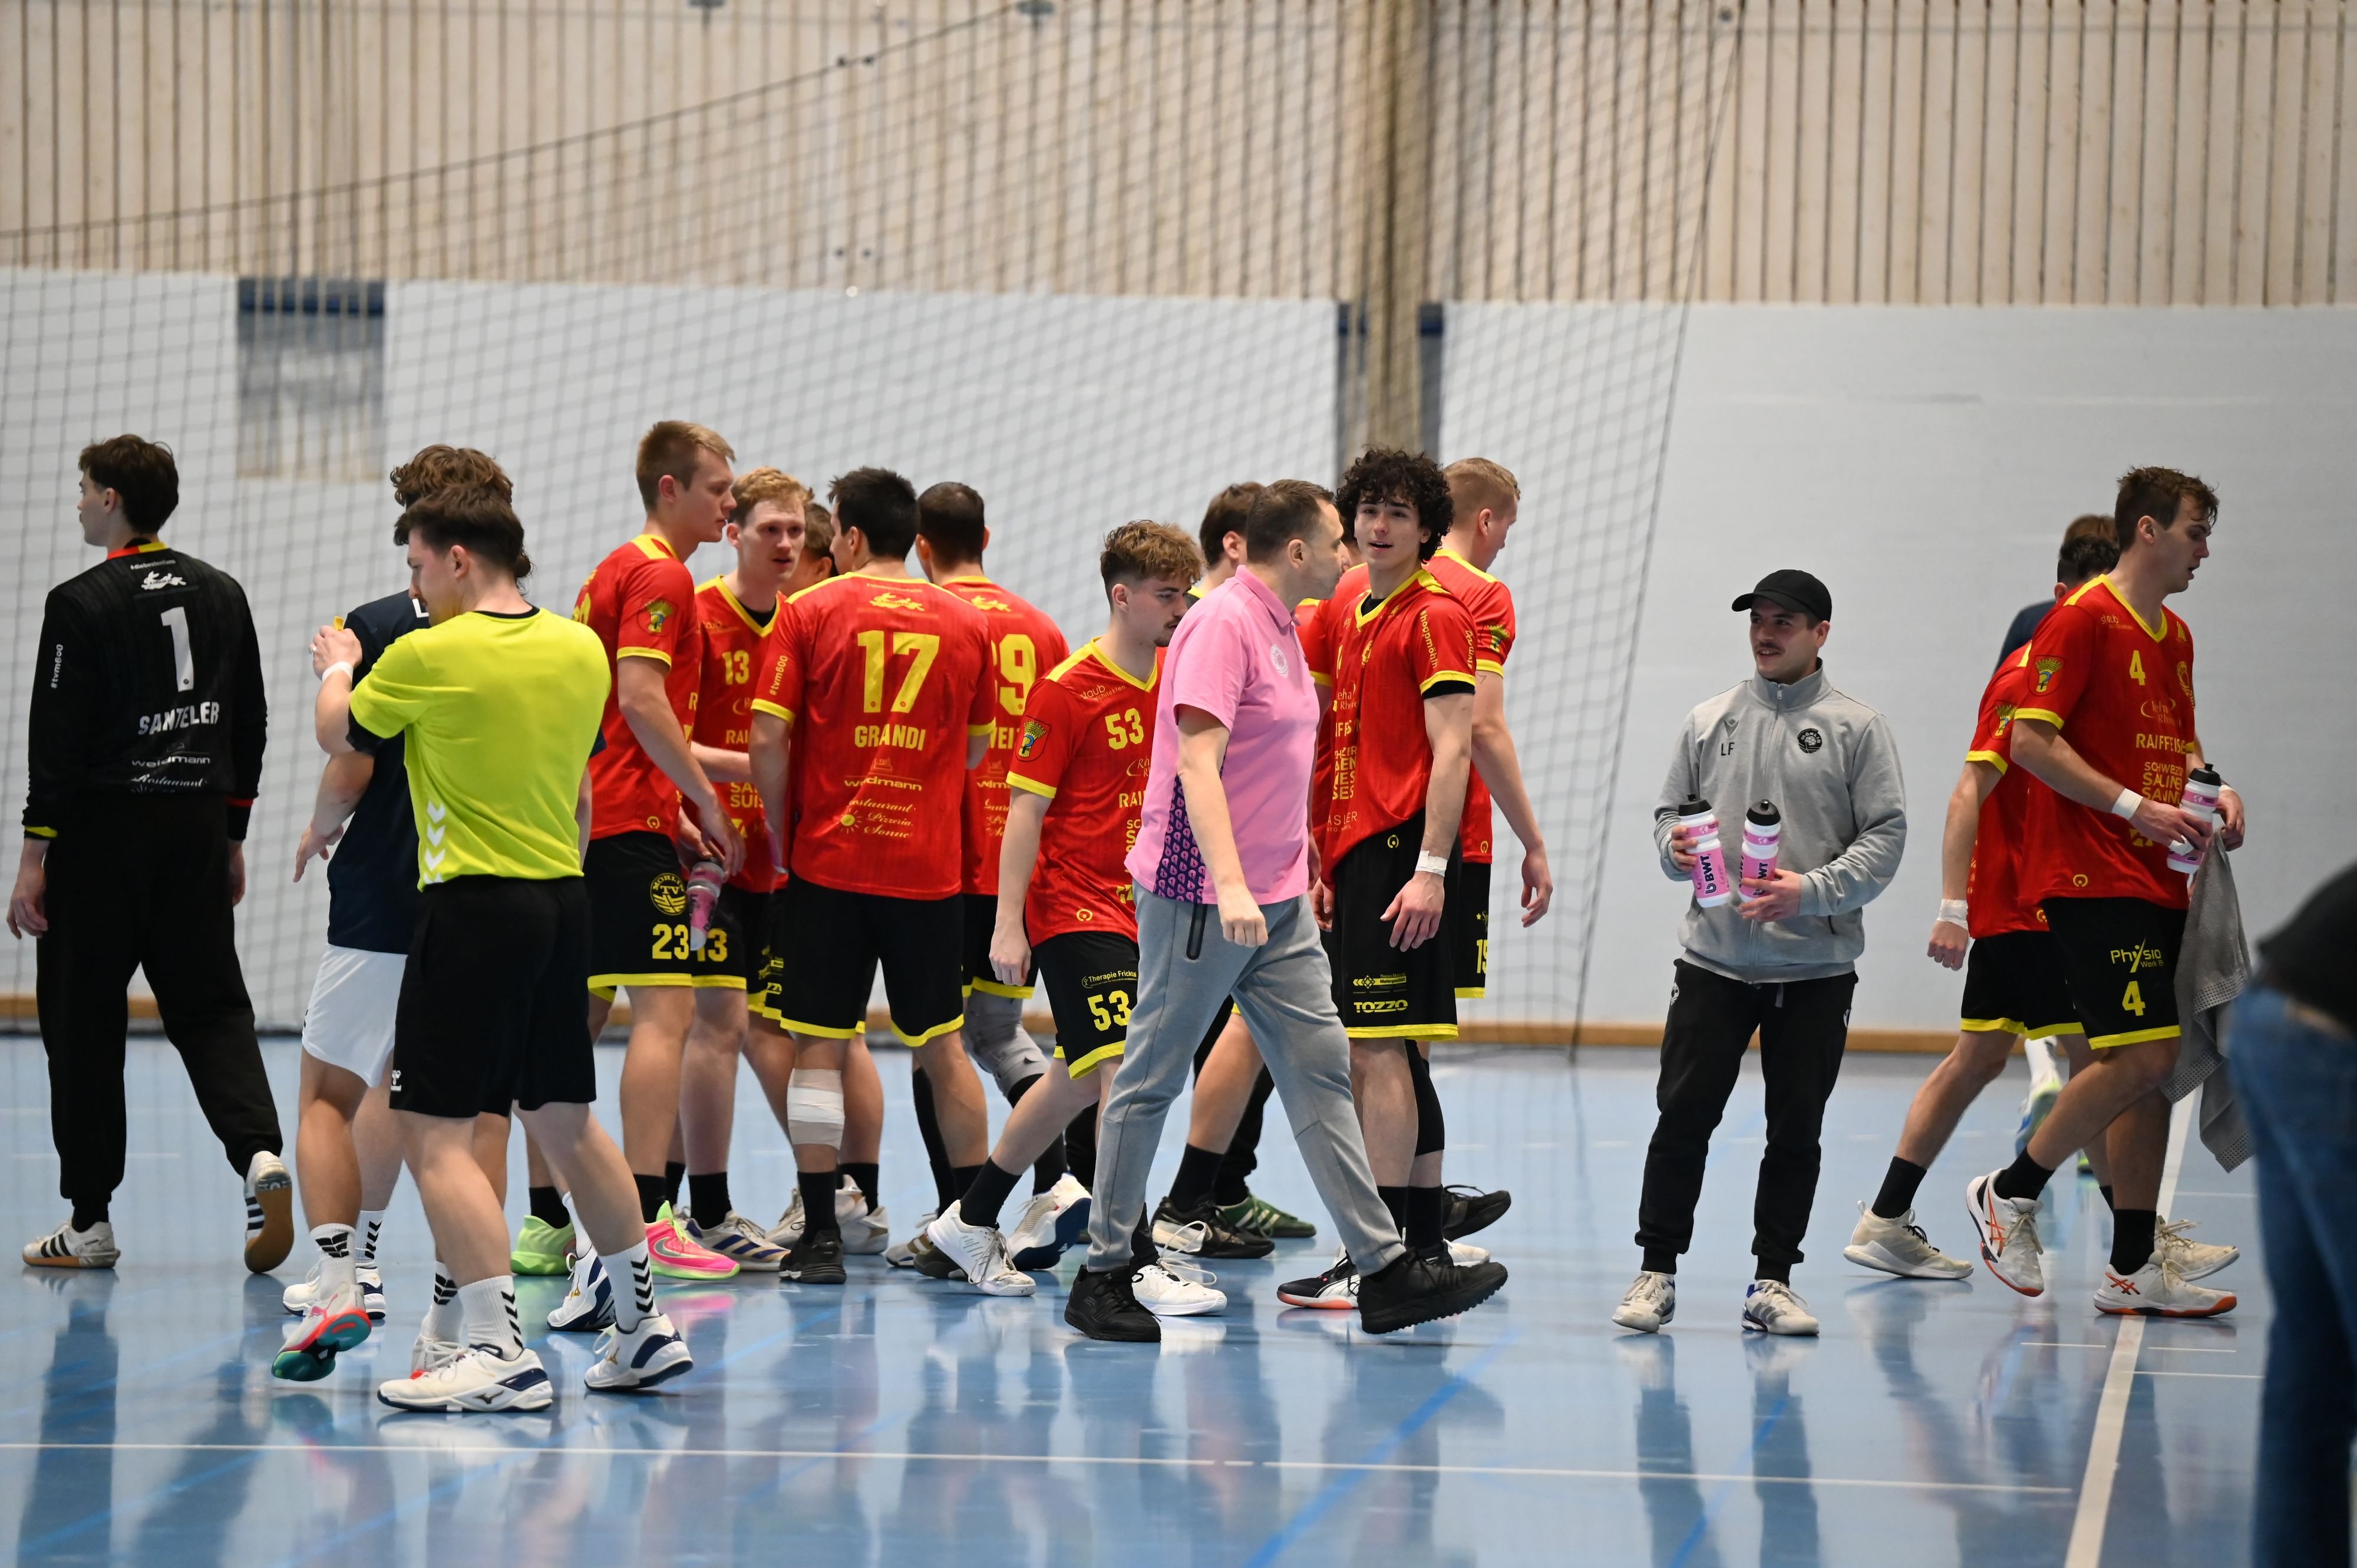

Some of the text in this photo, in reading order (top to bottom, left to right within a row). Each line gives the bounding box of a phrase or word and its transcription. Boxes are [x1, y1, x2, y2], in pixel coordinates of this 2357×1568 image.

[51, 643, 64, 689] #tvm600
[160, 606, 194, 692] 1
[722, 649, 750, 685] 13
[769, 655, 788, 696] #tvm600
[857, 630, 940, 713] 17
[991, 633, 1036, 716] 9
[2129, 649, 2146, 686] 4
[138, 701, 220, 735] SANTELER
[1104, 707, 1144, 750] 53
[854, 724, 926, 751] GRANDI
[1720, 742, 1735, 756] LF
[131, 756, 210, 768] weidmann
[844, 775, 922, 791] wdmann
[849, 798, 913, 813] estaurant
[1699, 855, 1715, 882] BWT
[1757, 862, 1768, 880] WT
[659, 885, 679, 895] TV
[652, 923, 689, 960] 23
[1088, 971, 1117, 983] Therapie
[1087, 990, 1132, 1031] 53
[1353, 999, 1408, 1014] TOZZO
[2122, 981, 2146, 1016] 4
